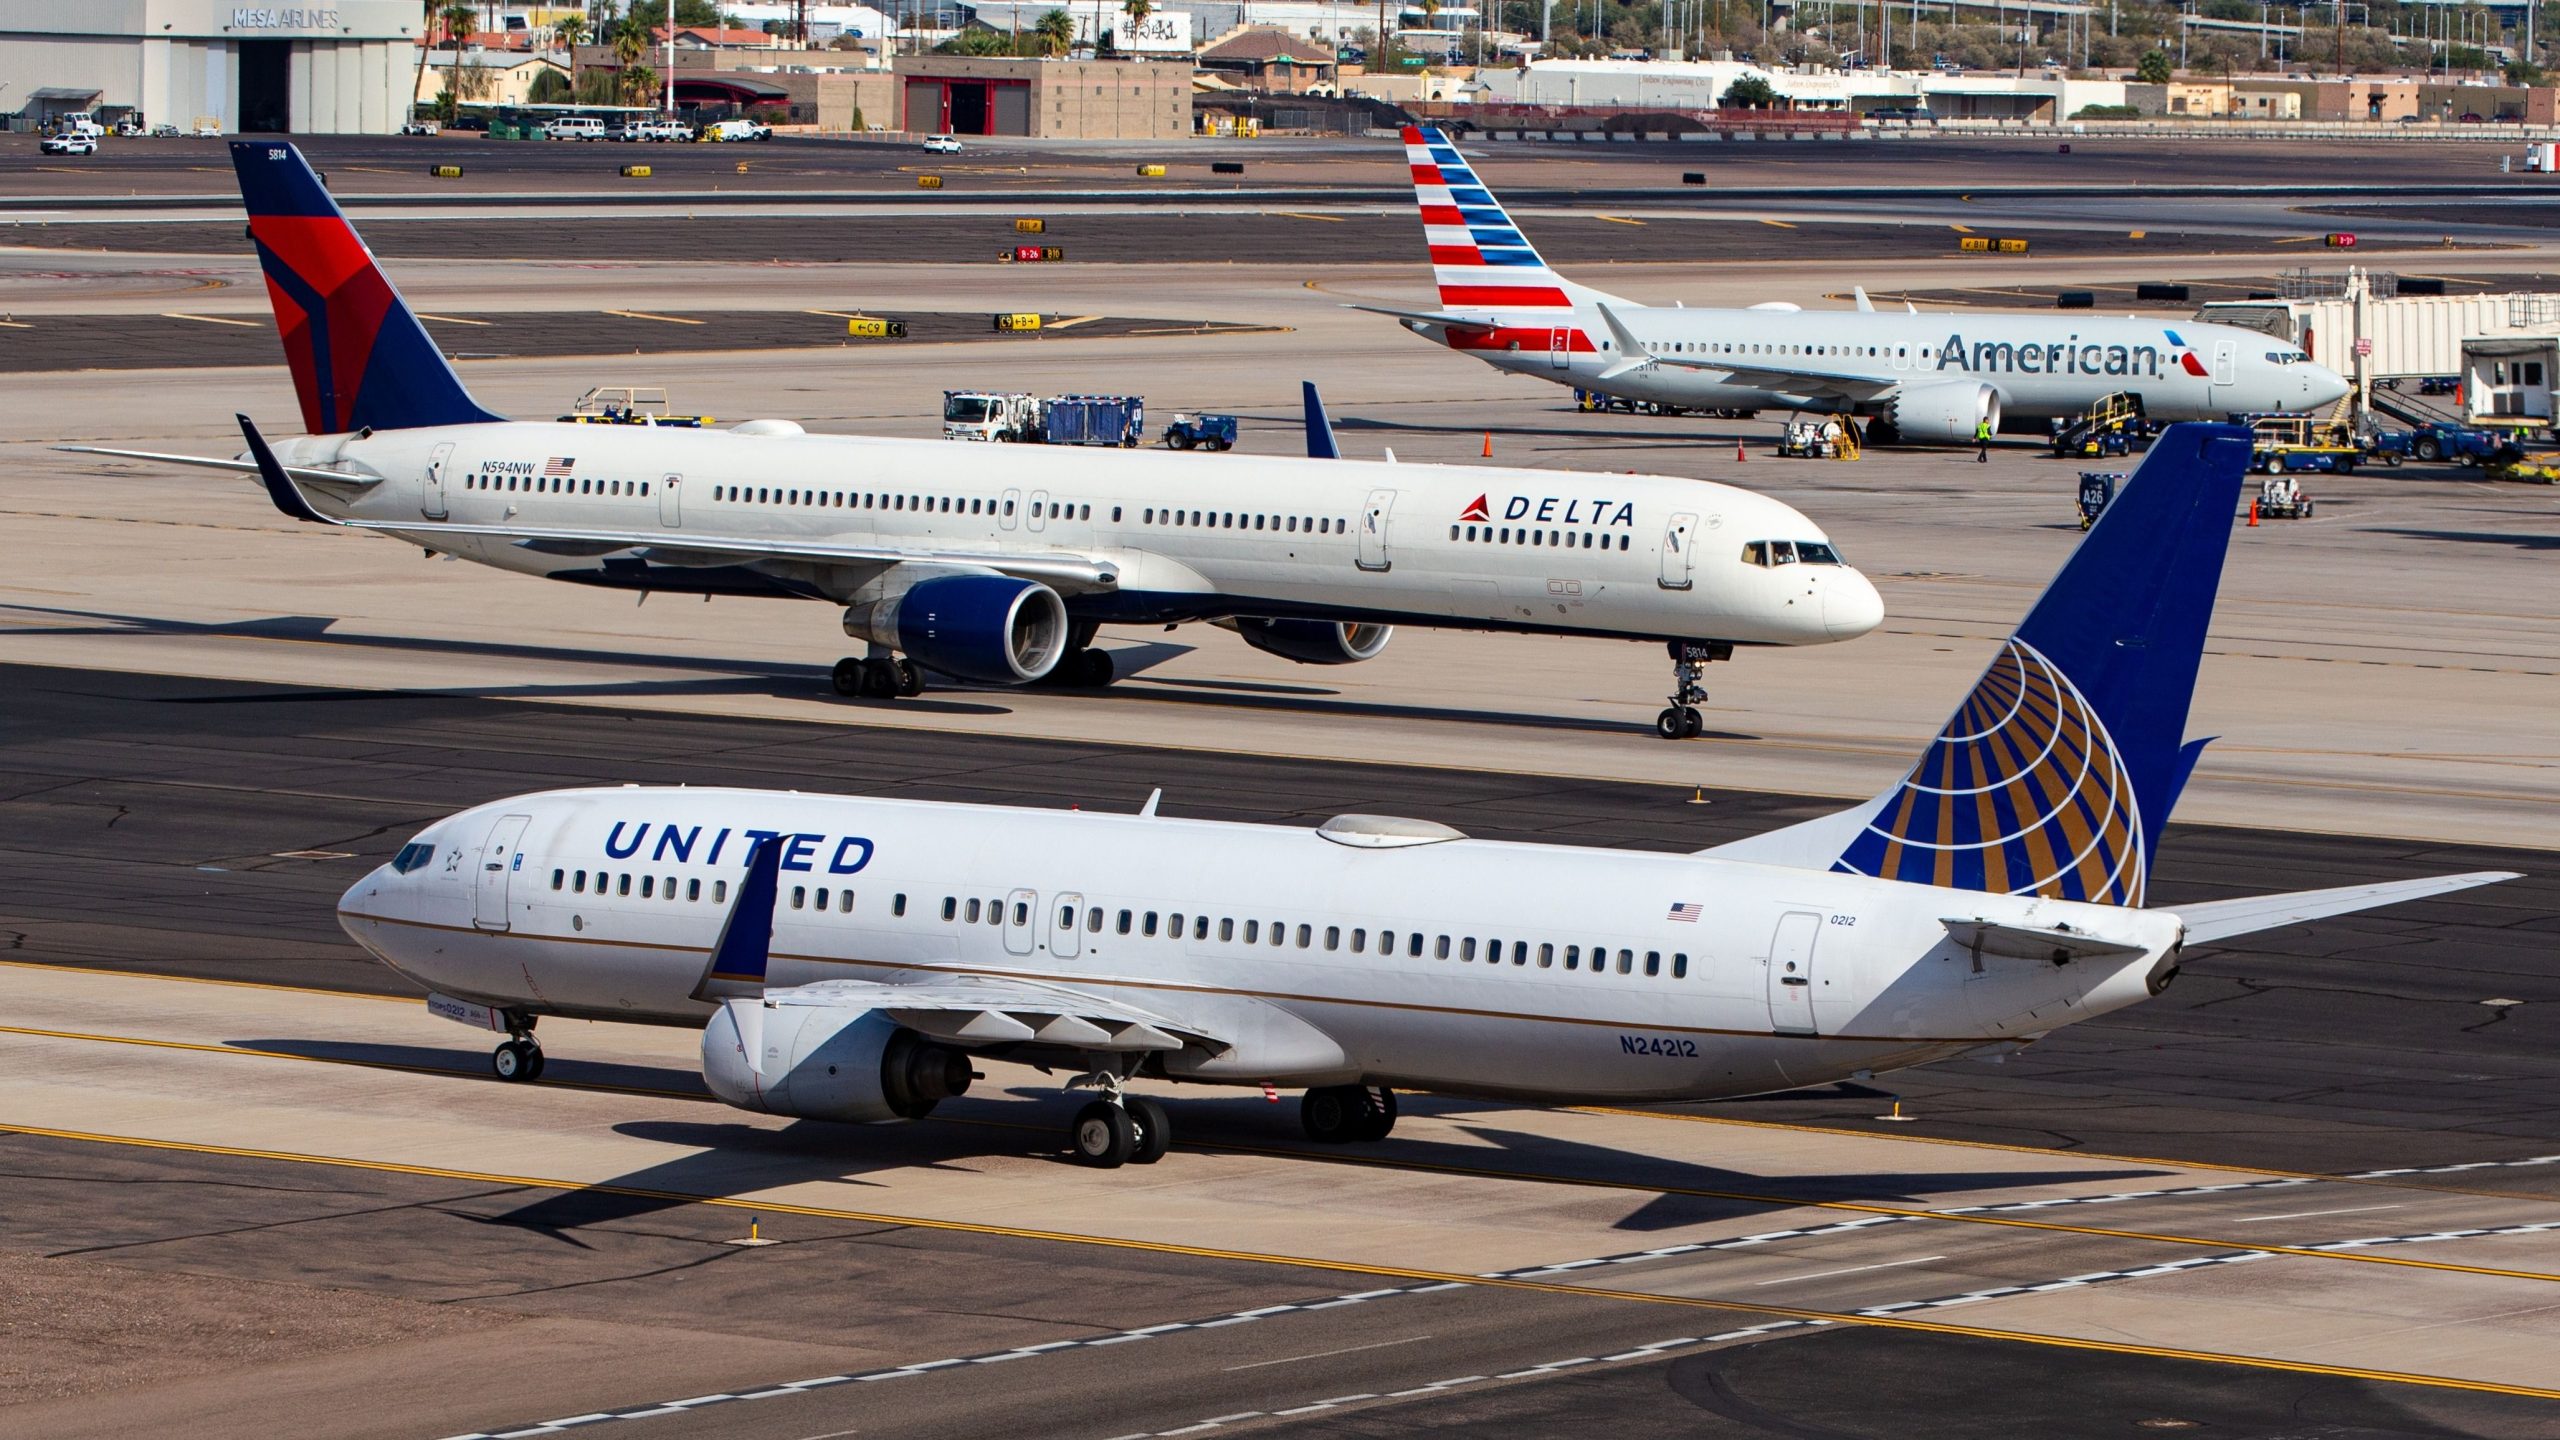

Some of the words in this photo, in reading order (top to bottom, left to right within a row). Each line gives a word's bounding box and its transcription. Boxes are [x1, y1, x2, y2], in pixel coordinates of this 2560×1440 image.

[232, 8, 278, 29] MESA
[279, 8, 339, 29] AIRLINES
[268, 149, 287, 161] 5814
[1021, 249, 1039, 259] 8-26
[866, 322, 881, 333] C9
[891, 323, 898, 334] C
[999, 316, 1012, 327] C9
[1021, 316, 1027, 327] B
[1936, 334, 2157, 375] American
[481, 460, 536, 474] N594NW
[2083, 489, 2104, 505] A26
[1504, 495, 1634, 527] DELTA
[1686, 646, 1708, 658] 5814
[604, 820, 875, 875] UNITED
[1830, 914, 1856, 927] 0212
[446, 1003, 466, 1017] 0212
[1619, 1035, 1699, 1058] N24212
